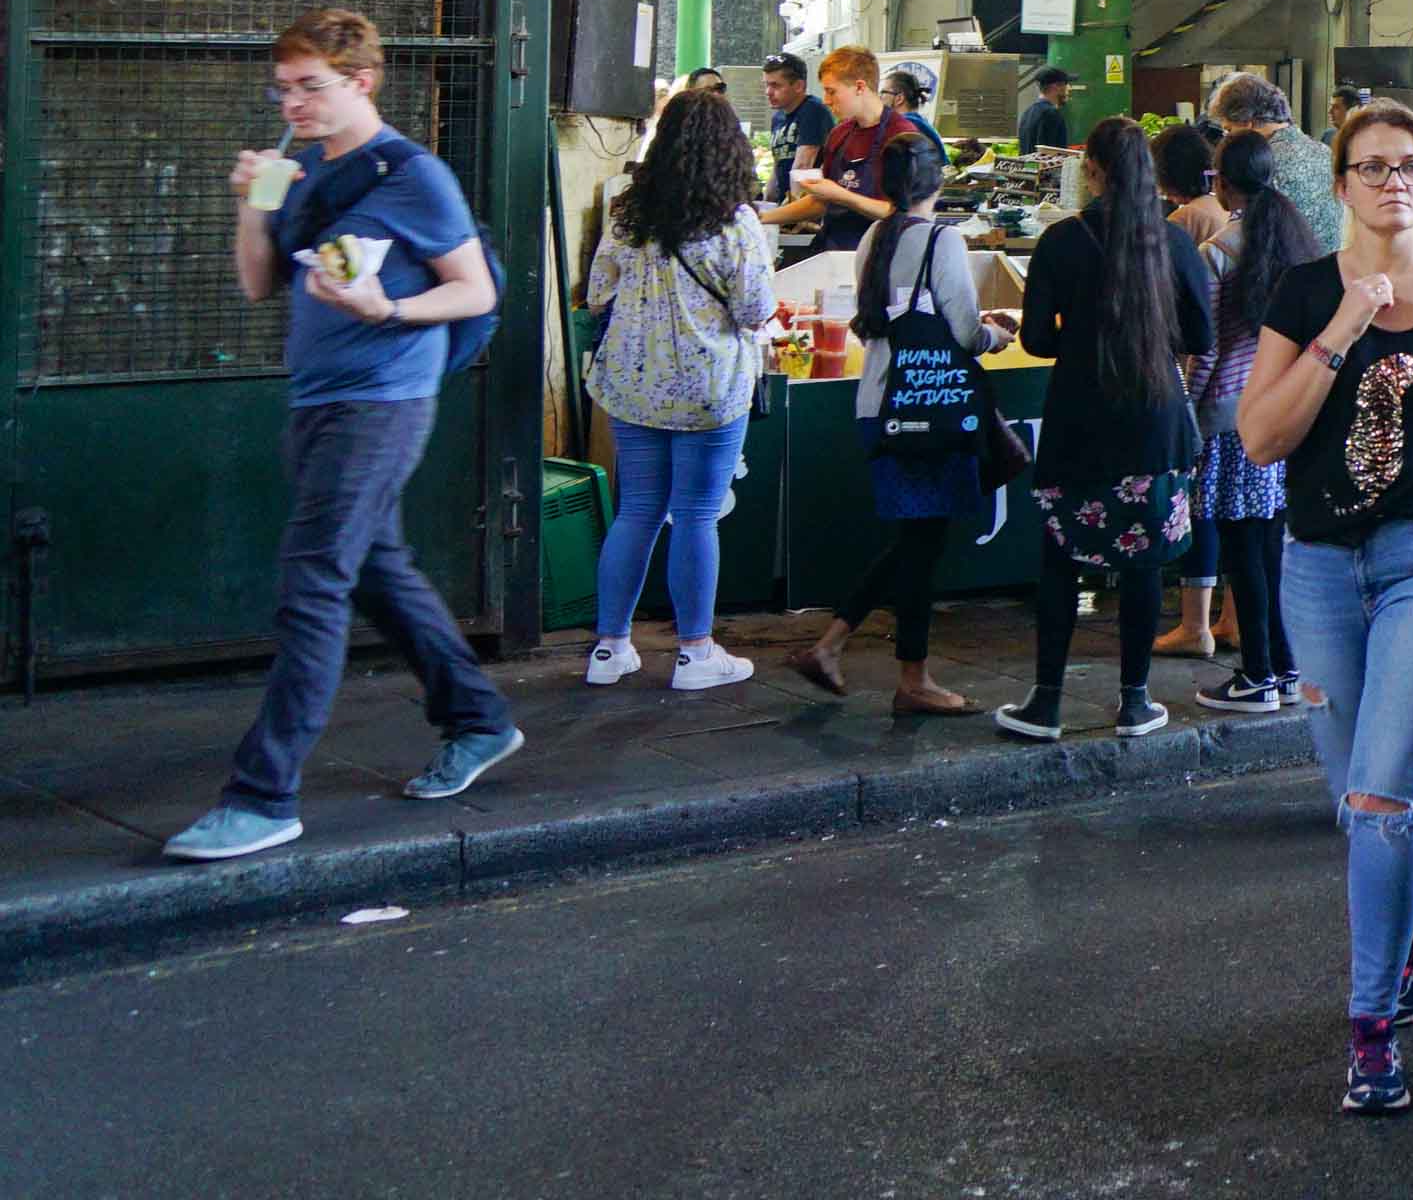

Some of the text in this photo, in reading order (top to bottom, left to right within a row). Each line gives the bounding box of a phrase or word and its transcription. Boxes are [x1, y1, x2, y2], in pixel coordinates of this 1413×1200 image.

[897, 349, 951, 368] HUMAN
[904, 369, 969, 389] RIGHTS
[892, 388, 975, 408] ACTIVIST
